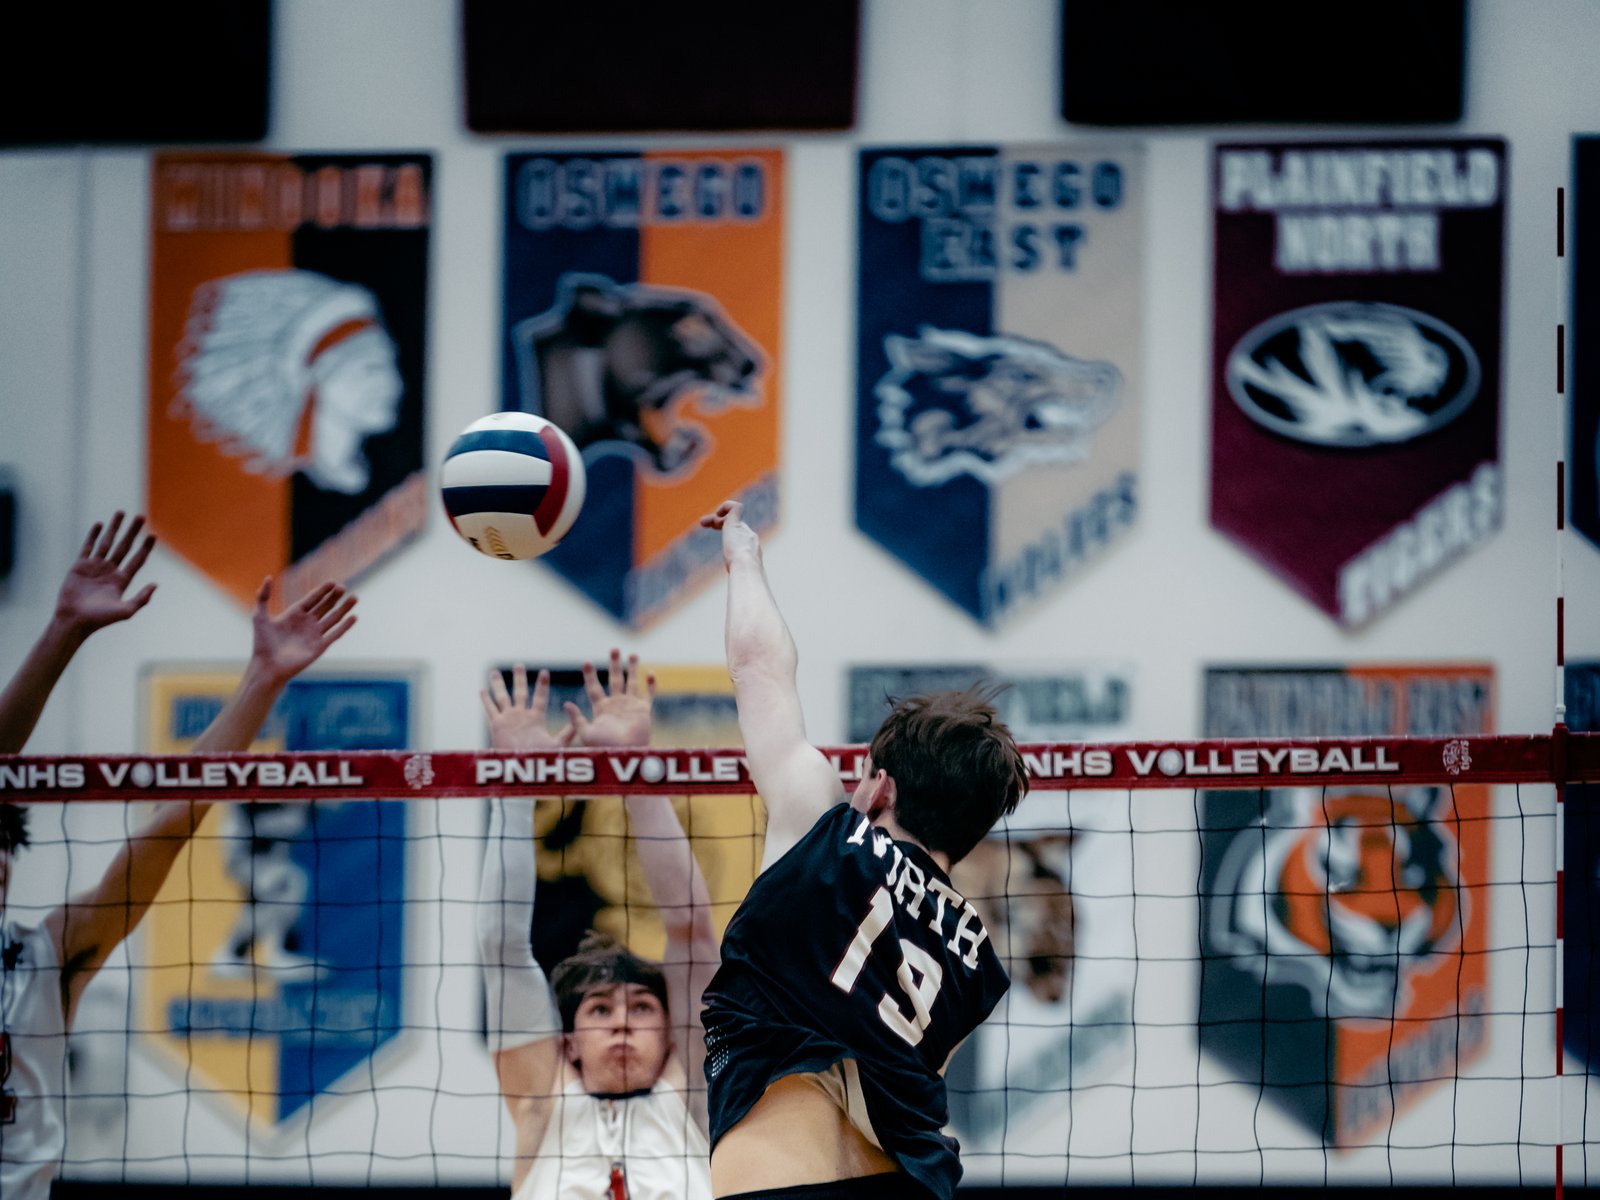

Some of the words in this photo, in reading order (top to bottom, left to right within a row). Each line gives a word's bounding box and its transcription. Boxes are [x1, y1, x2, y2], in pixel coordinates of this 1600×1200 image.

[514, 156, 766, 229] OSWEGO
[867, 155, 1125, 222] OSWEGO
[1219, 147, 1499, 211] PLAINFIELD
[920, 216, 1088, 282] EAST
[1273, 211, 1443, 272] NORTH
[99, 761, 364, 789] VOLLEYBALL
[475, 757, 595, 784] PNHS
[1022, 750, 1113, 778] NHS
[1125, 746, 1400, 777] VOLLEYBALL
[829, 885, 944, 1048] 19
